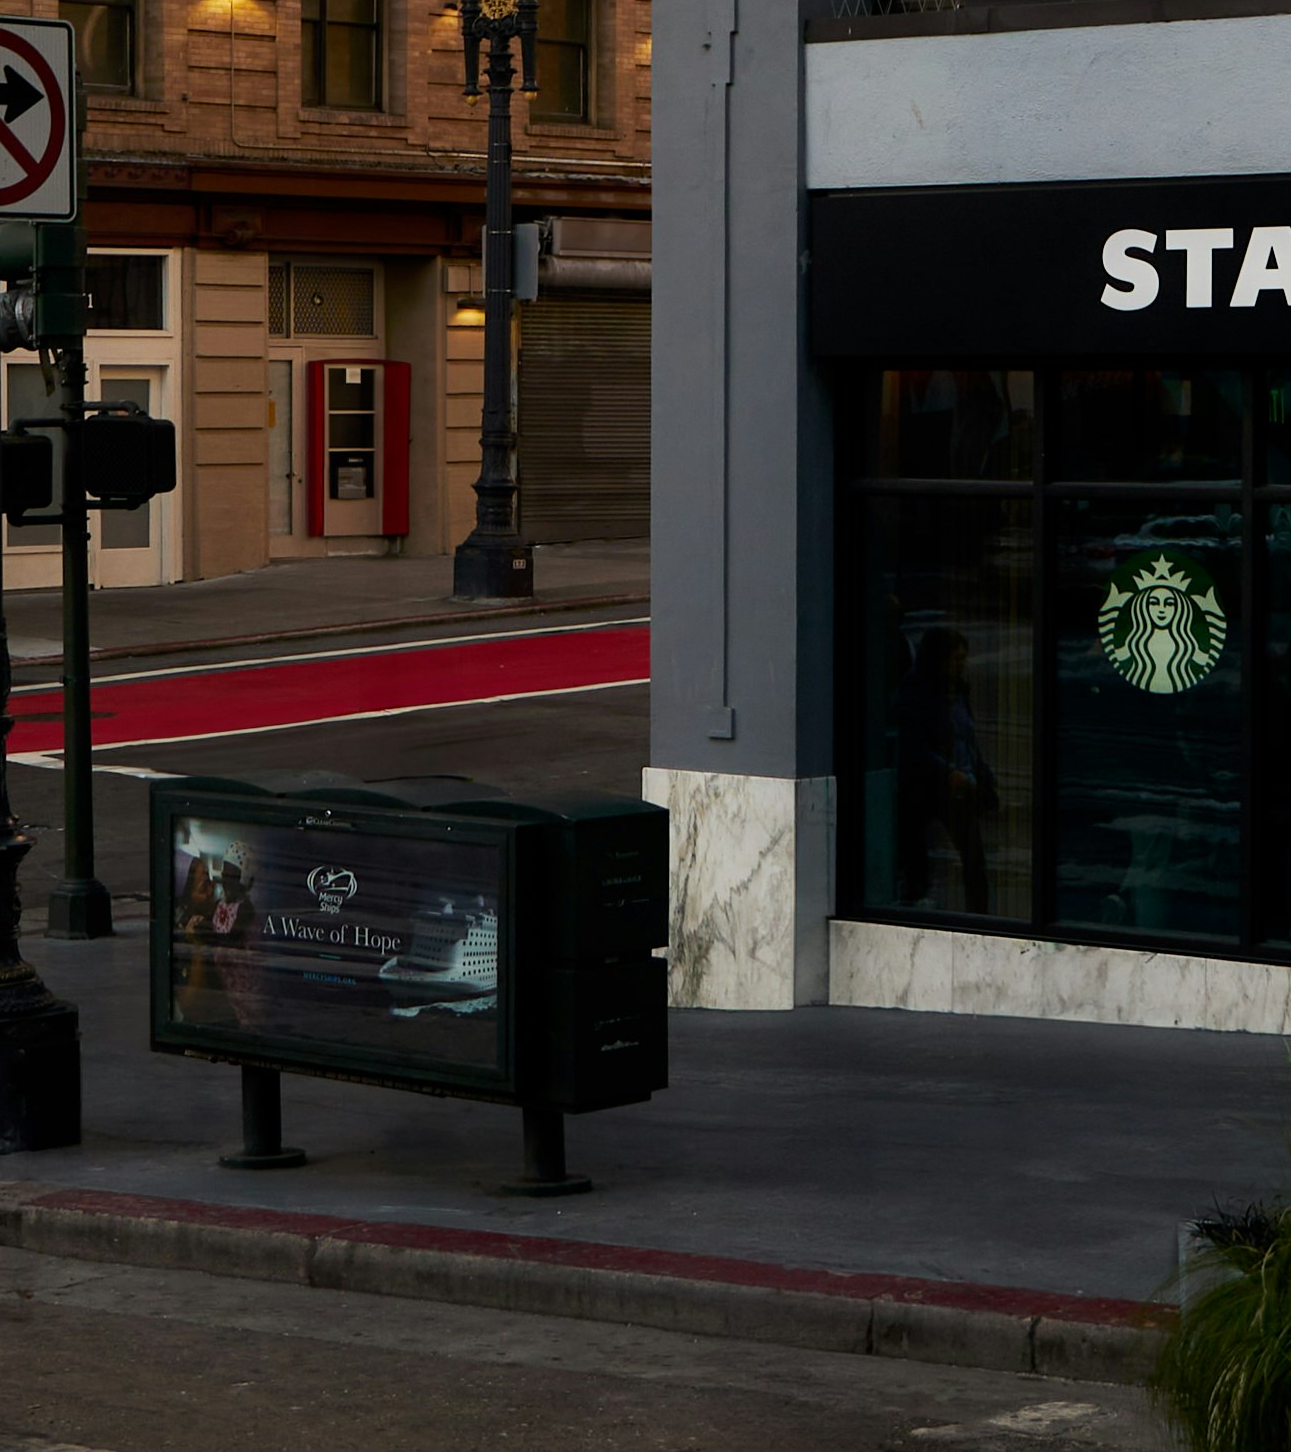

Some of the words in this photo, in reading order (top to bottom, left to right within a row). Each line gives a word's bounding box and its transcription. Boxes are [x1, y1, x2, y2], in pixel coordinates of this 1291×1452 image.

[318, 892, 343, 904] Mercy
[319, 902, 341, 915] Ships
[263, 914, 276, 935] A
[281, 916, 325, 941] Wave
[329, 924, 349, 944] of
[354, 926, 401, 955] Hope
